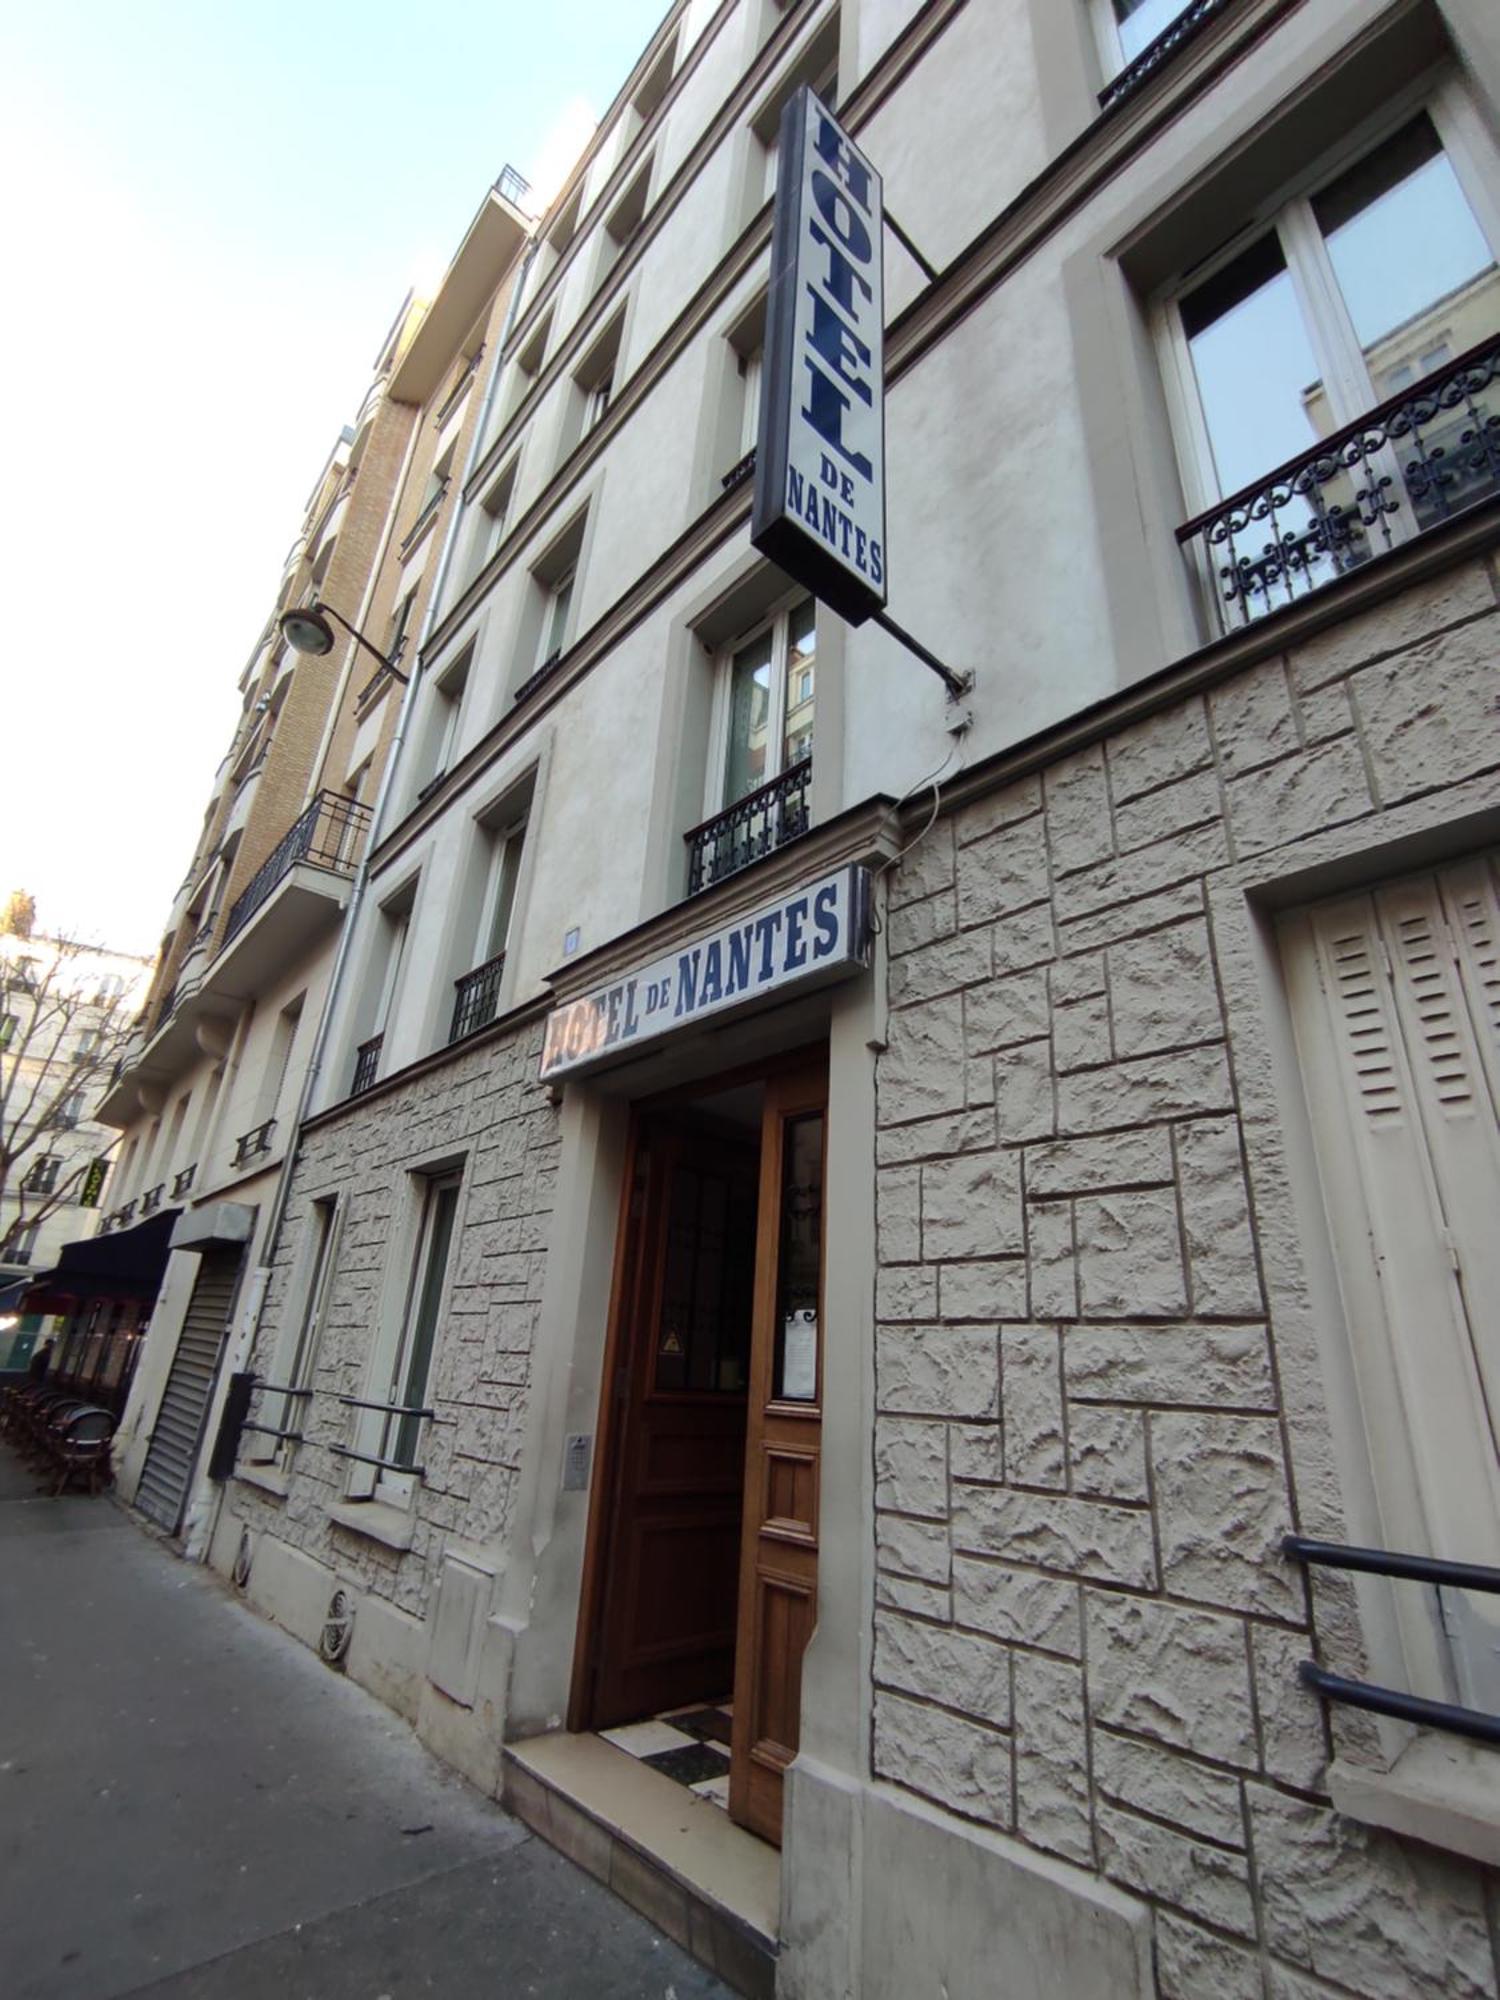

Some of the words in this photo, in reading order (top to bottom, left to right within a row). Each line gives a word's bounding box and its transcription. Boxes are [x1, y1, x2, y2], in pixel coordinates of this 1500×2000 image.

[801, 108, 873, 484] HOTEL
[788, 464, 882, 584] NANTES
[820, 452, 854, 508] DE
[545, 979, 639, 1070] HOTEL
[645, 977, 671, 1015] DE
[674, 883, 838, 1017] NANTES
